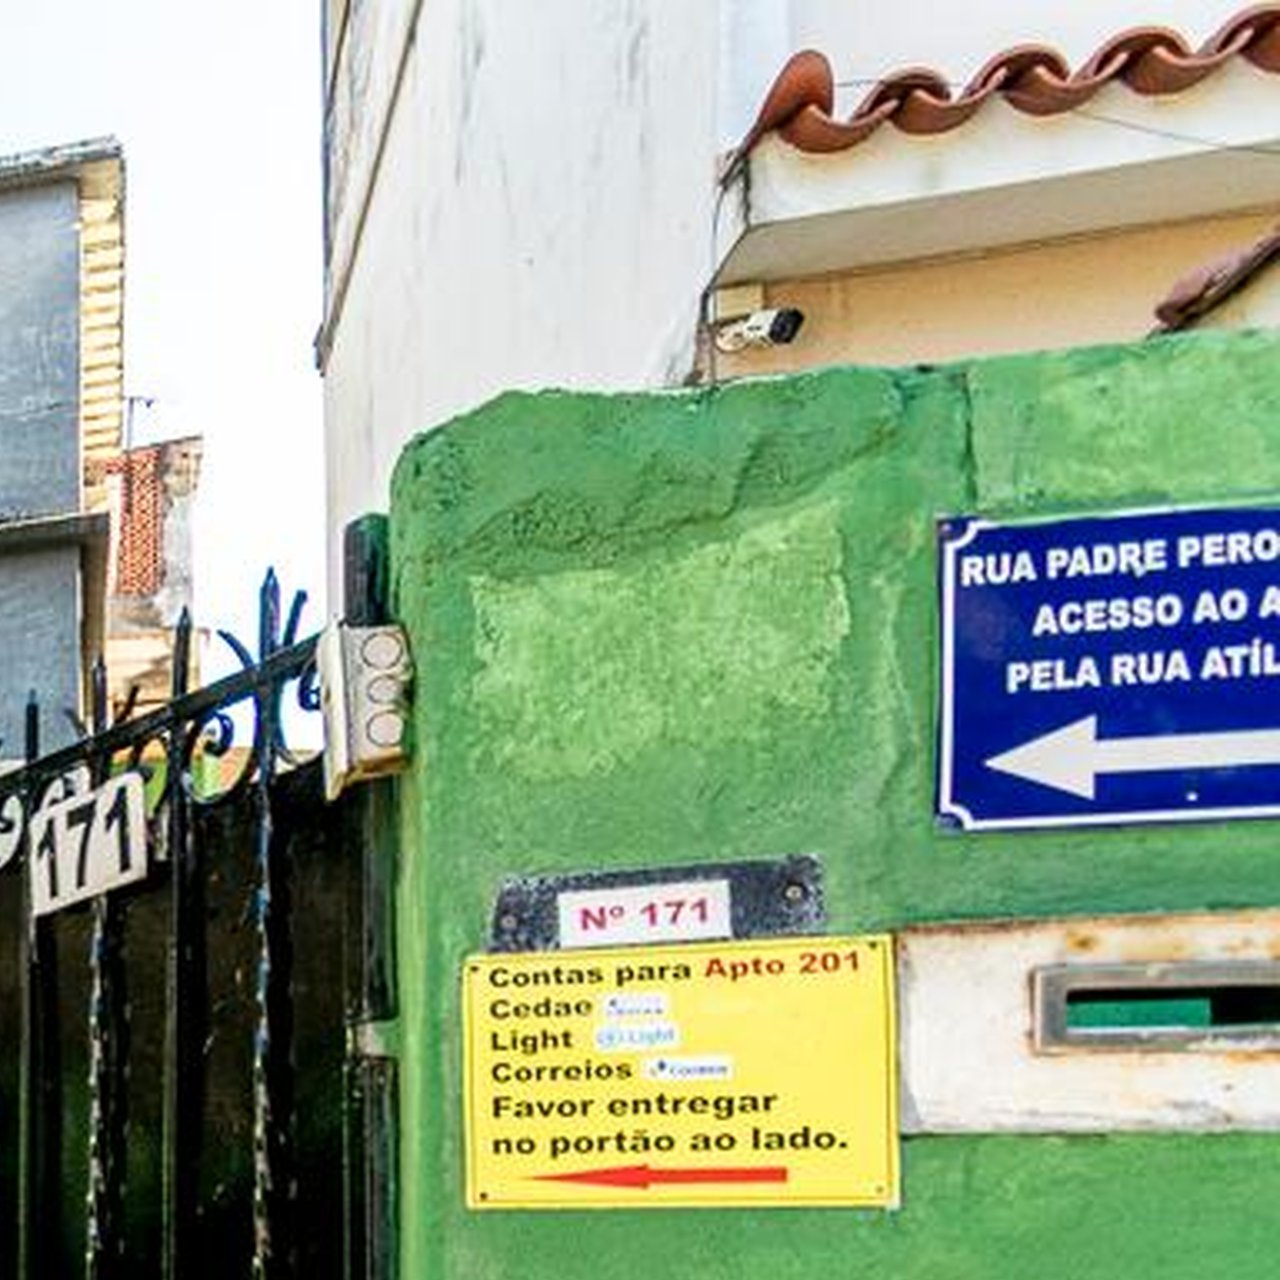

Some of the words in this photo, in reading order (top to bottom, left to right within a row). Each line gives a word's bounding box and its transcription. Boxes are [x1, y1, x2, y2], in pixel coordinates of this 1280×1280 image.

[961, 551, 1037, 587] RUA
[1046, 538, 1167, 579] PADRE
[1032, 594, 1183, 636] ACESSO
[1193, 589, 1248, 624] AO
[1006, 657, 1101, 694] PELA
[1111, 650, 1191, 685] RUA
[37, 785, 132, 901] 171
[640, 898, 709, 927] 171
[488, 964, 604, 988] Contas
[615, 963, 692, 985] para
[704, 957, 785, 982] Apto
[799, 951, 860, 974] 201
[489, 996, 593, 1020] Cedae
[491, 1028, 574, 1056] Light
[491, 1058, 633, 1083] Correios
[491, 1096, 595, 1119] Favor
[607, 1092, 779, 1119] entregar
[492, 1137, 536, 1156] no
[551, 1130, 676, 1160] portão
[689, 1132, 737, 1153] ao
[750, 1127, 849, 1152] lado.
